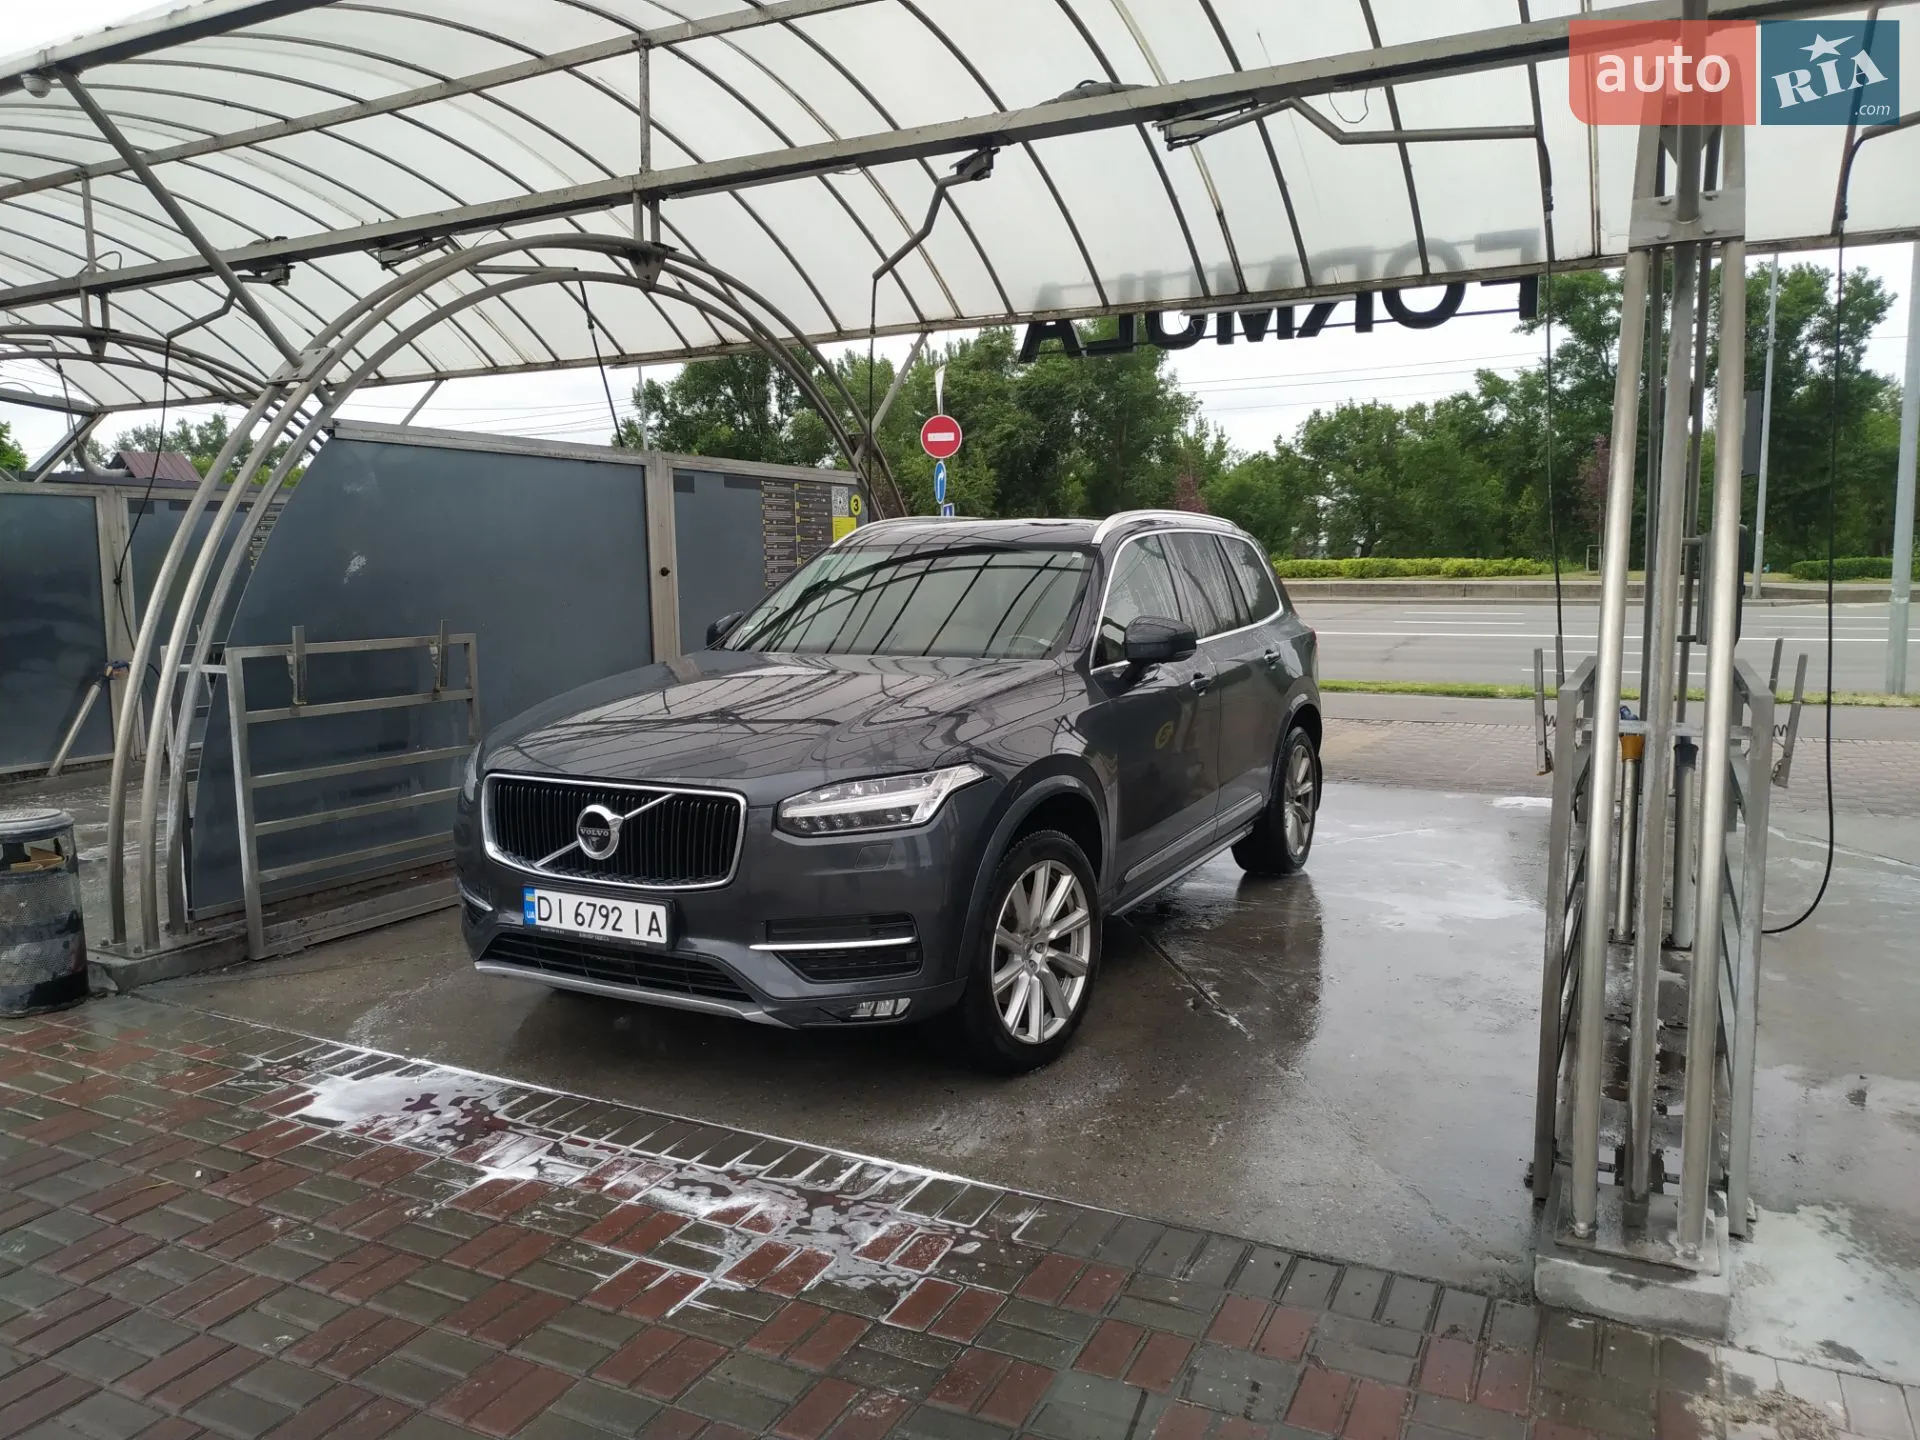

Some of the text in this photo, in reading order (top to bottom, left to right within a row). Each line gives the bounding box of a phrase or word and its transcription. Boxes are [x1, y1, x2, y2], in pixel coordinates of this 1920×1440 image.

[853, 498, 859, 512] 3
[580, 828, 609, 837] VOLVO
[526, 911, 535, 919] UA
[537, 896, 663, 938] DI 6792 IA
